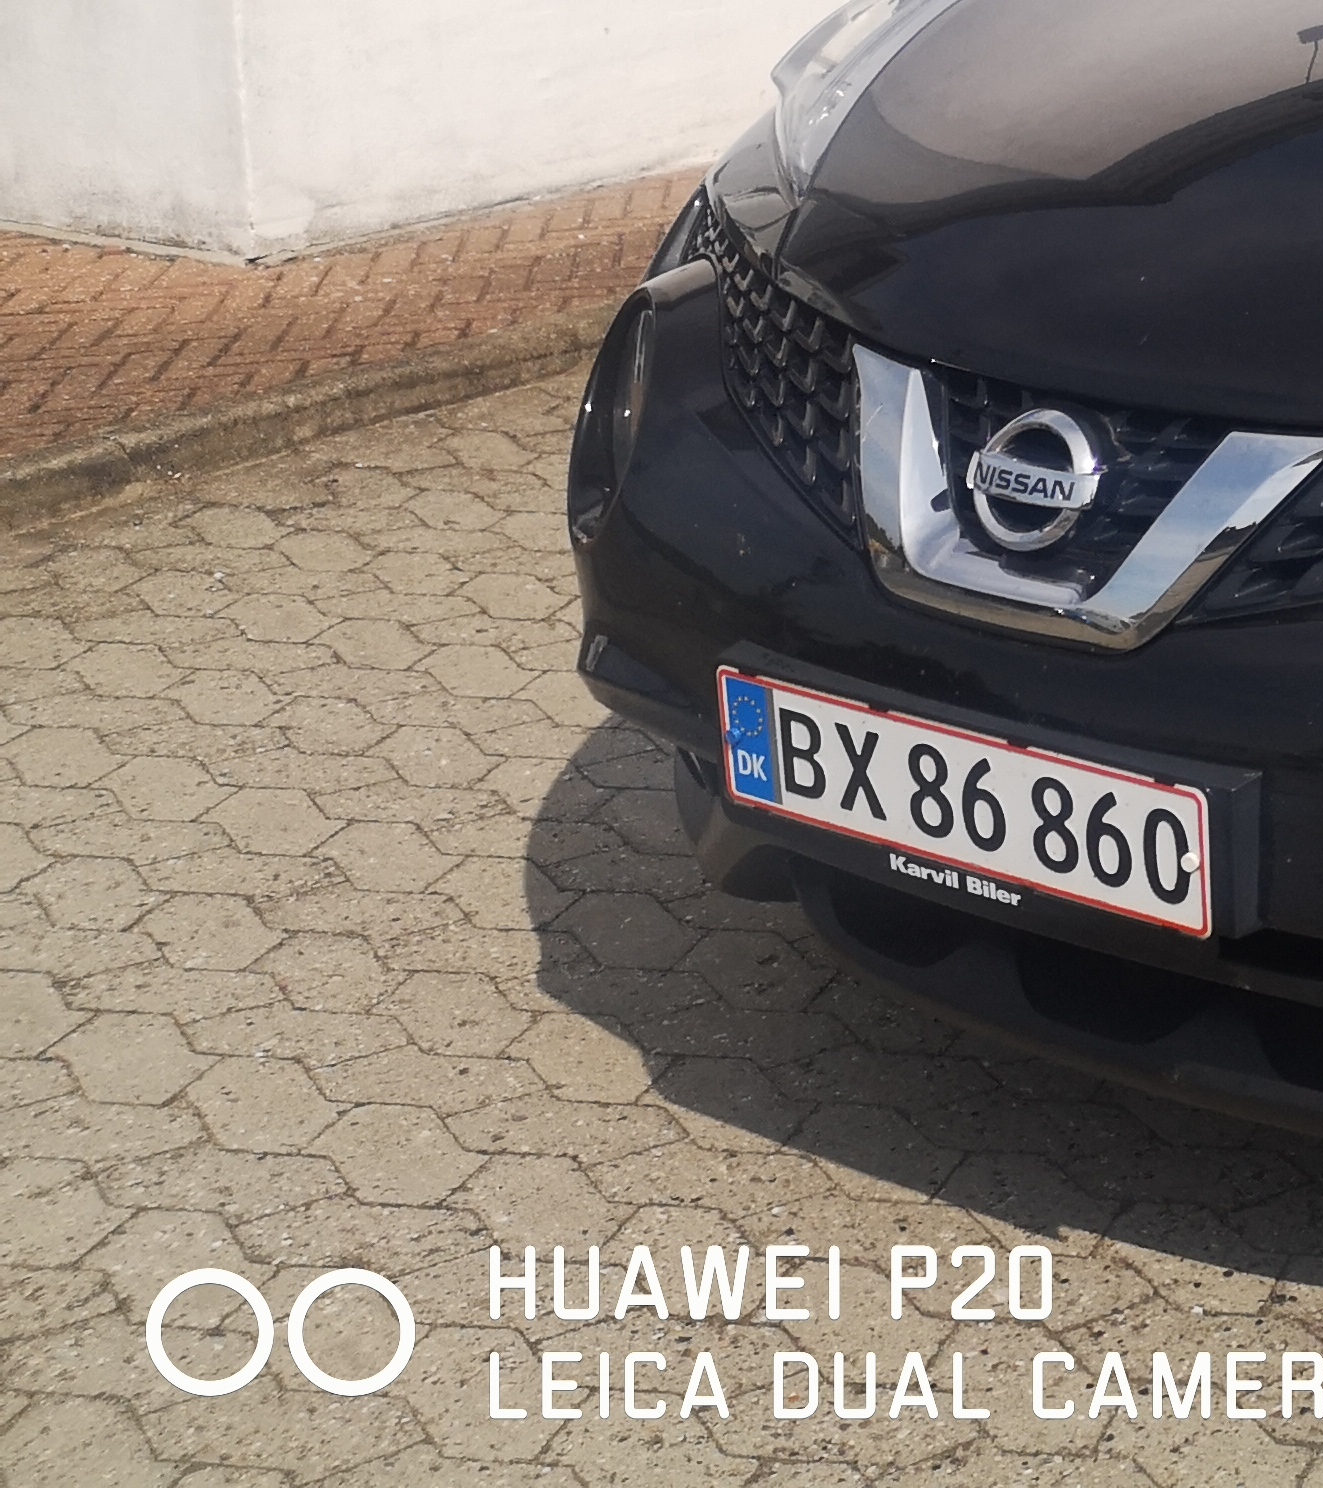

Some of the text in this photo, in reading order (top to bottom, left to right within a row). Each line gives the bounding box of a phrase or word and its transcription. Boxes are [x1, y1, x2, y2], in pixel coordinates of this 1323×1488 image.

[974, 461, 1076, 502] NISSAN
[736, 749, 769, 782] DK
[778, 707, 1192, 905] BX 86 860
[889, 852, 1022, 907] Karvil Biler
